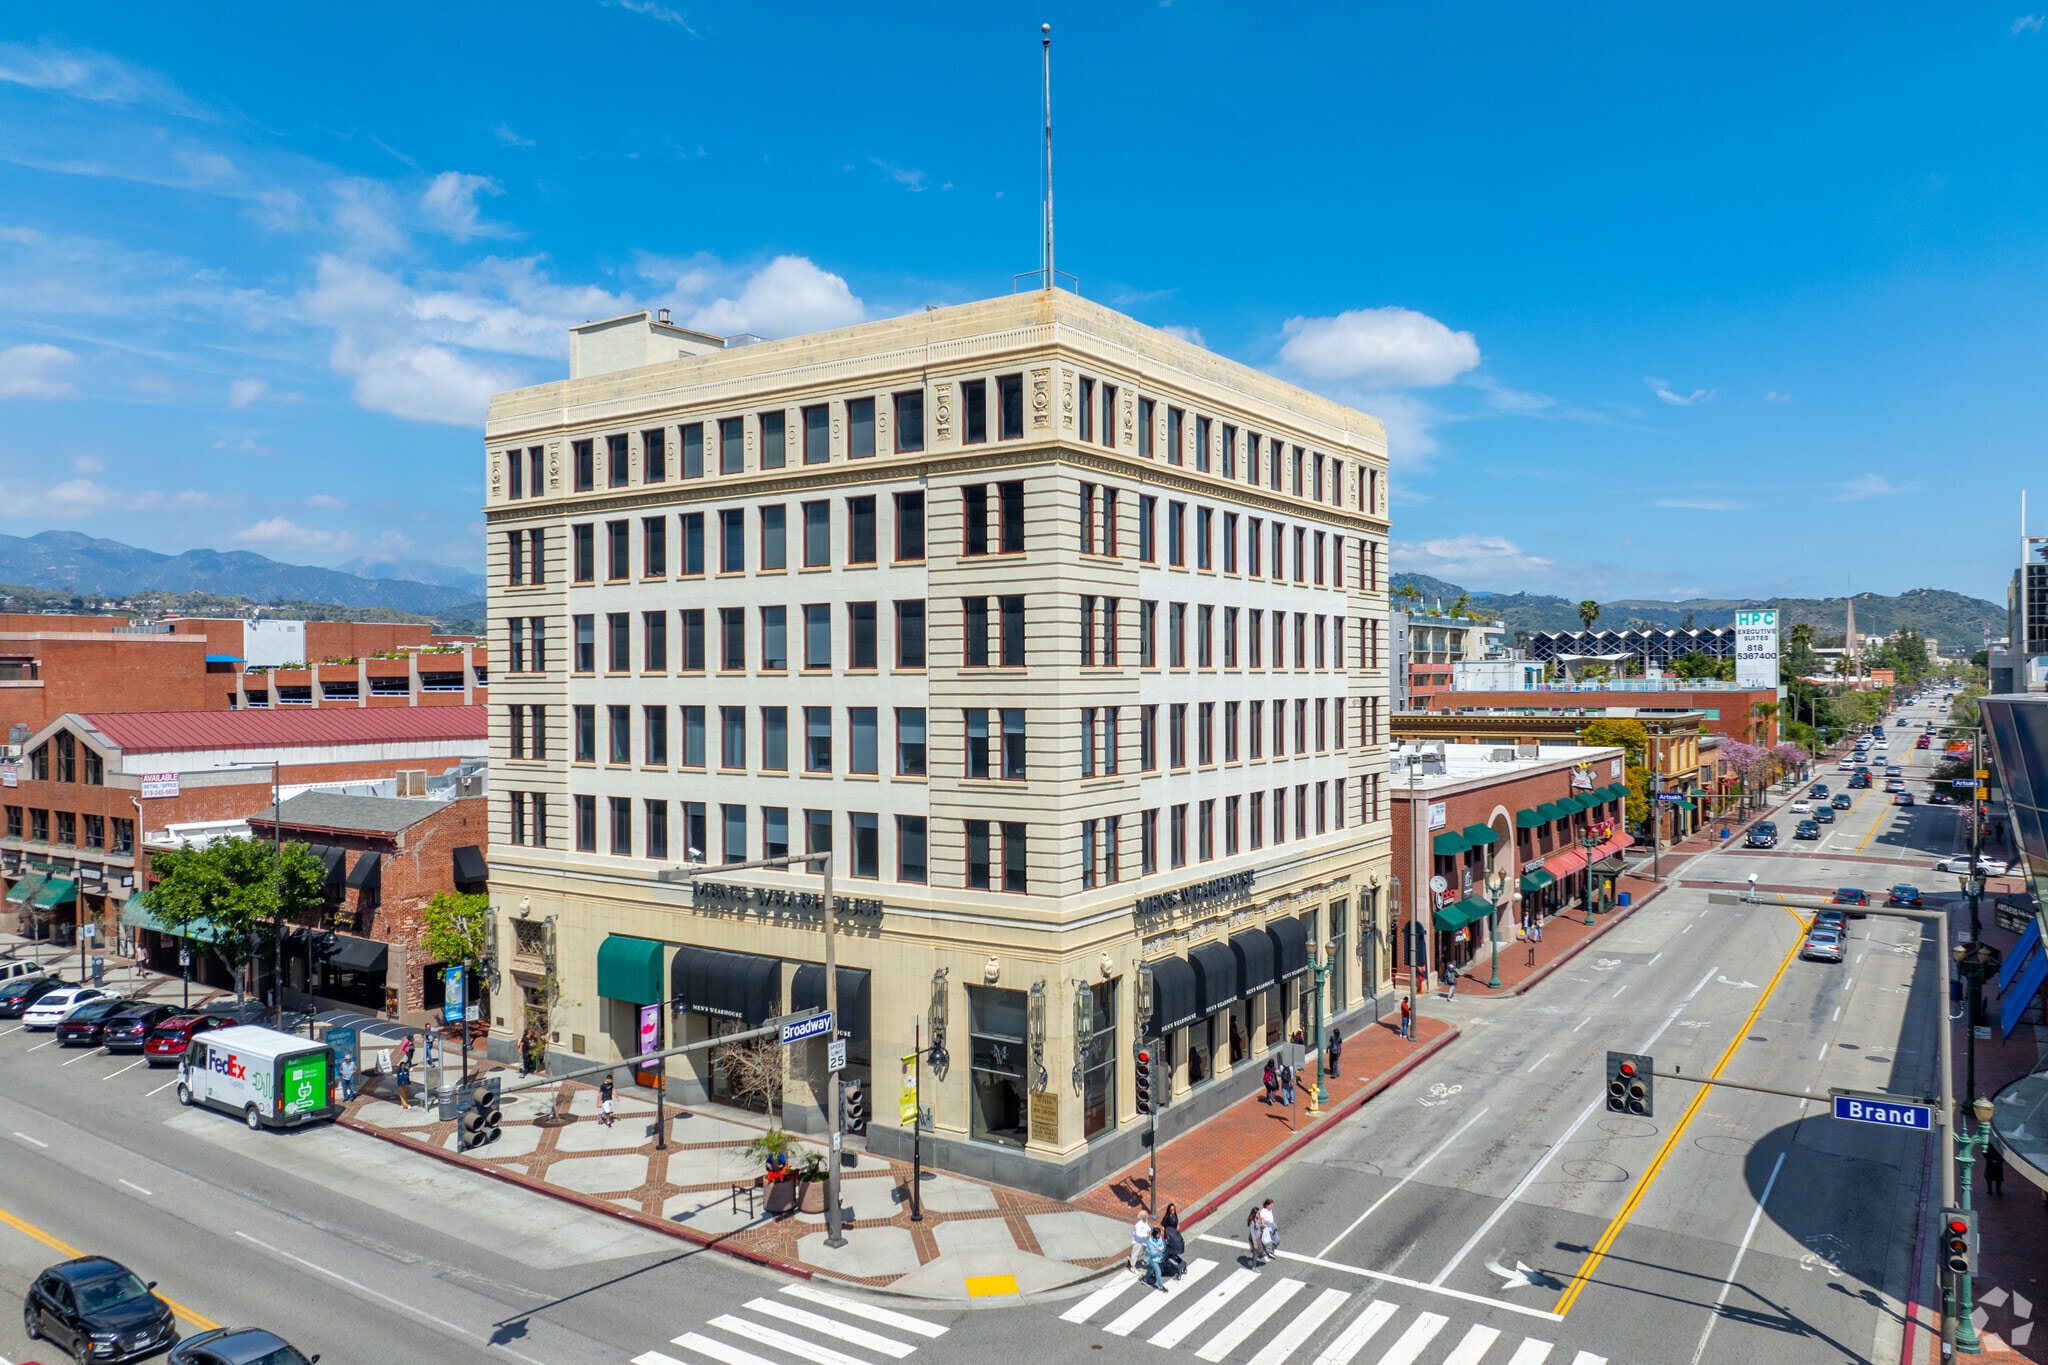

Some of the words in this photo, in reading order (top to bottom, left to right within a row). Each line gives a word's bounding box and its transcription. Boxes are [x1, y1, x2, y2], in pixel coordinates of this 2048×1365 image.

[1738, 611, 1774, 626] HPC
[1746, 644, 1763, 652] 818
[1737, 652, 1777, 660] 5367400
[143, 773, 178, 783] AVAILABLE
[692, 880, 748, 904] MEN'S
[752, 887, 884, 919] WEARHOUSE
[1135, 890, 1178, 917] MEN'S
[1180, 869, 1256, 906] WEARHOUSE
[692, 1004, 709, 1012] MEN'S
[709, 1006, 743, 1018] WEARHOUSE
[783, 1014, 831, 1040] Broadway
[1161, 1021, 1173, 1033] MEN'S
[1173, 1012, 1197, 1027] WEARHOUSE
[829, 1042, 844, 1050] SPEED
[830, 1049, 843, 1057] LIMIT
[209, 1048, 247, 1081] FedEx
[830, 1055, 844, 1069] 25
[229, 1078, 245, 1090] Express
[1849, 1101, 1915, 1125] Brand
